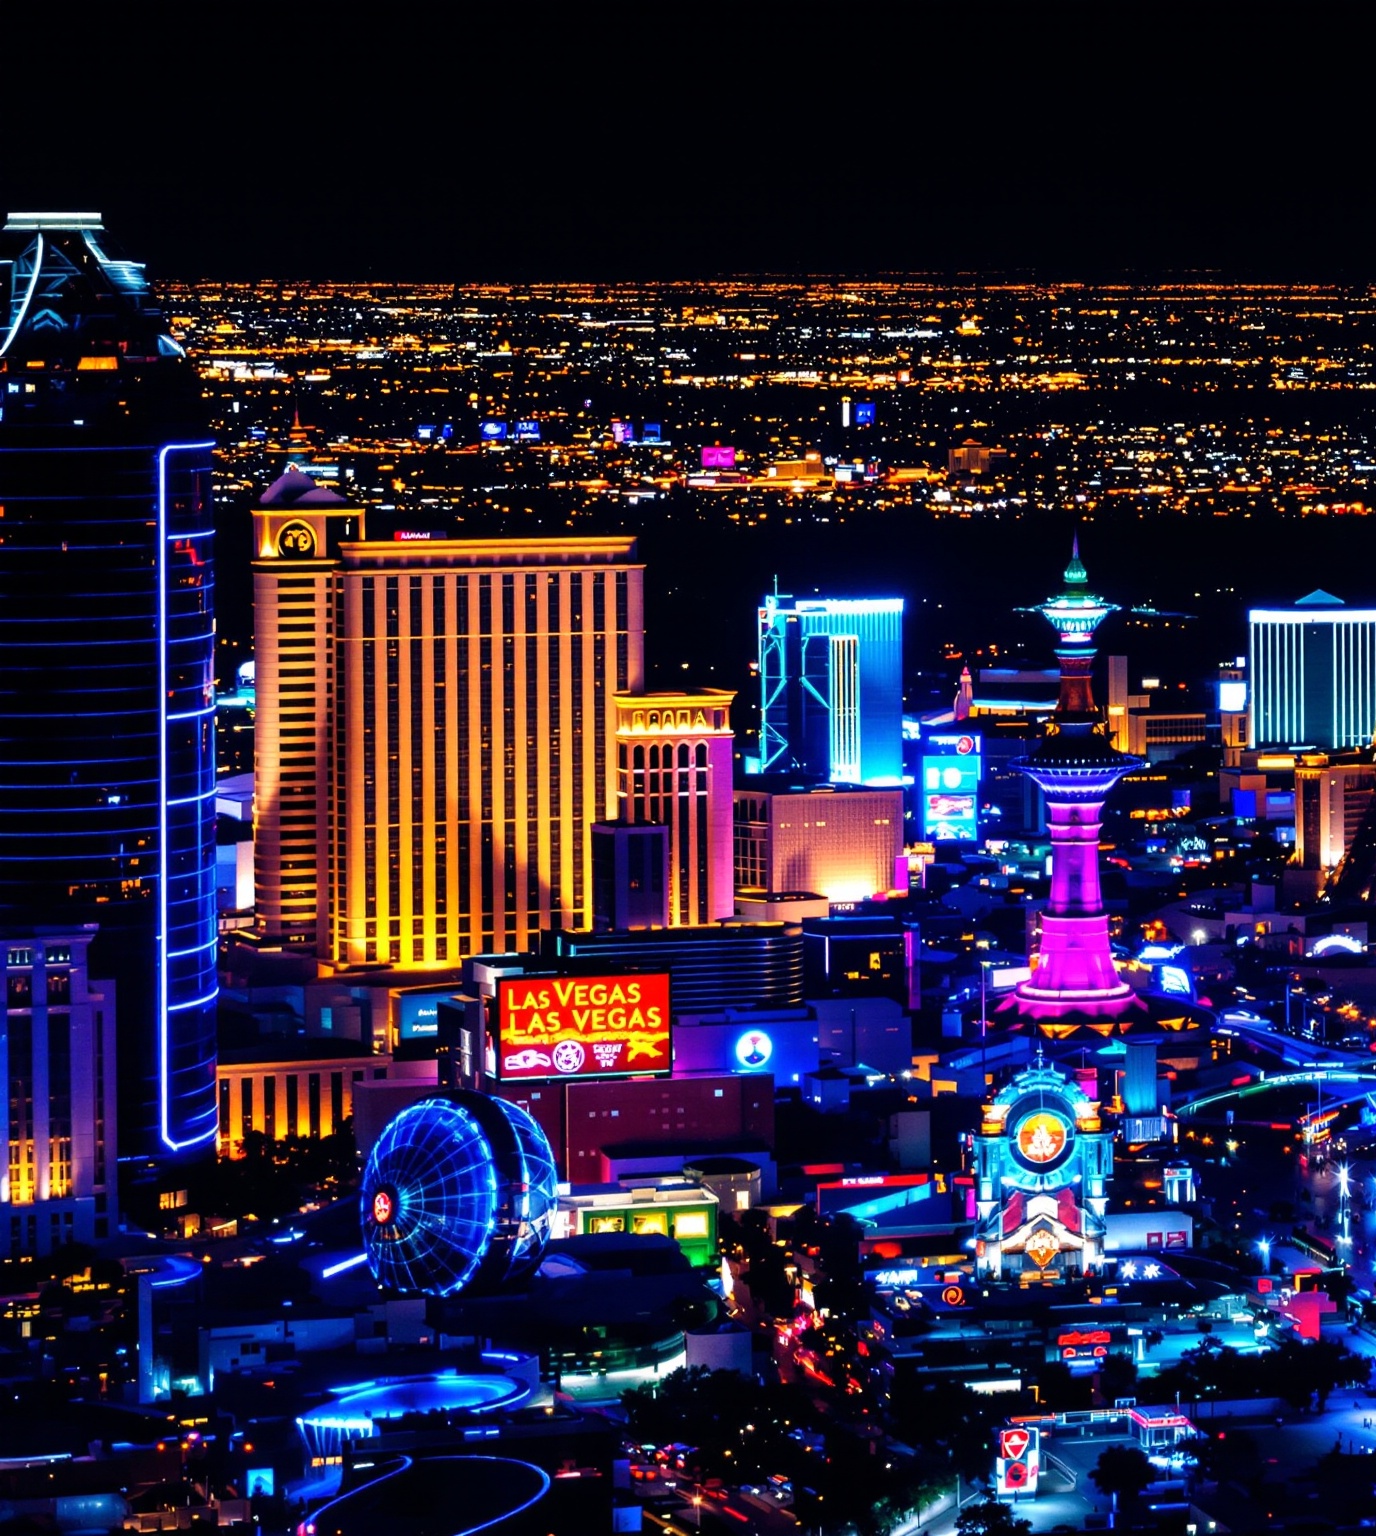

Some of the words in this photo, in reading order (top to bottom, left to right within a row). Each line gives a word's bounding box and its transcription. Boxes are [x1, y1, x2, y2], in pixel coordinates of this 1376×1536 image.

[508, 988, 550, 1010] LAS
[552, 981, 642, 1007] VEGAS
[509, 1012, 561, 1035] LAS
[571, 1006, 662, 1032] VEGAS
